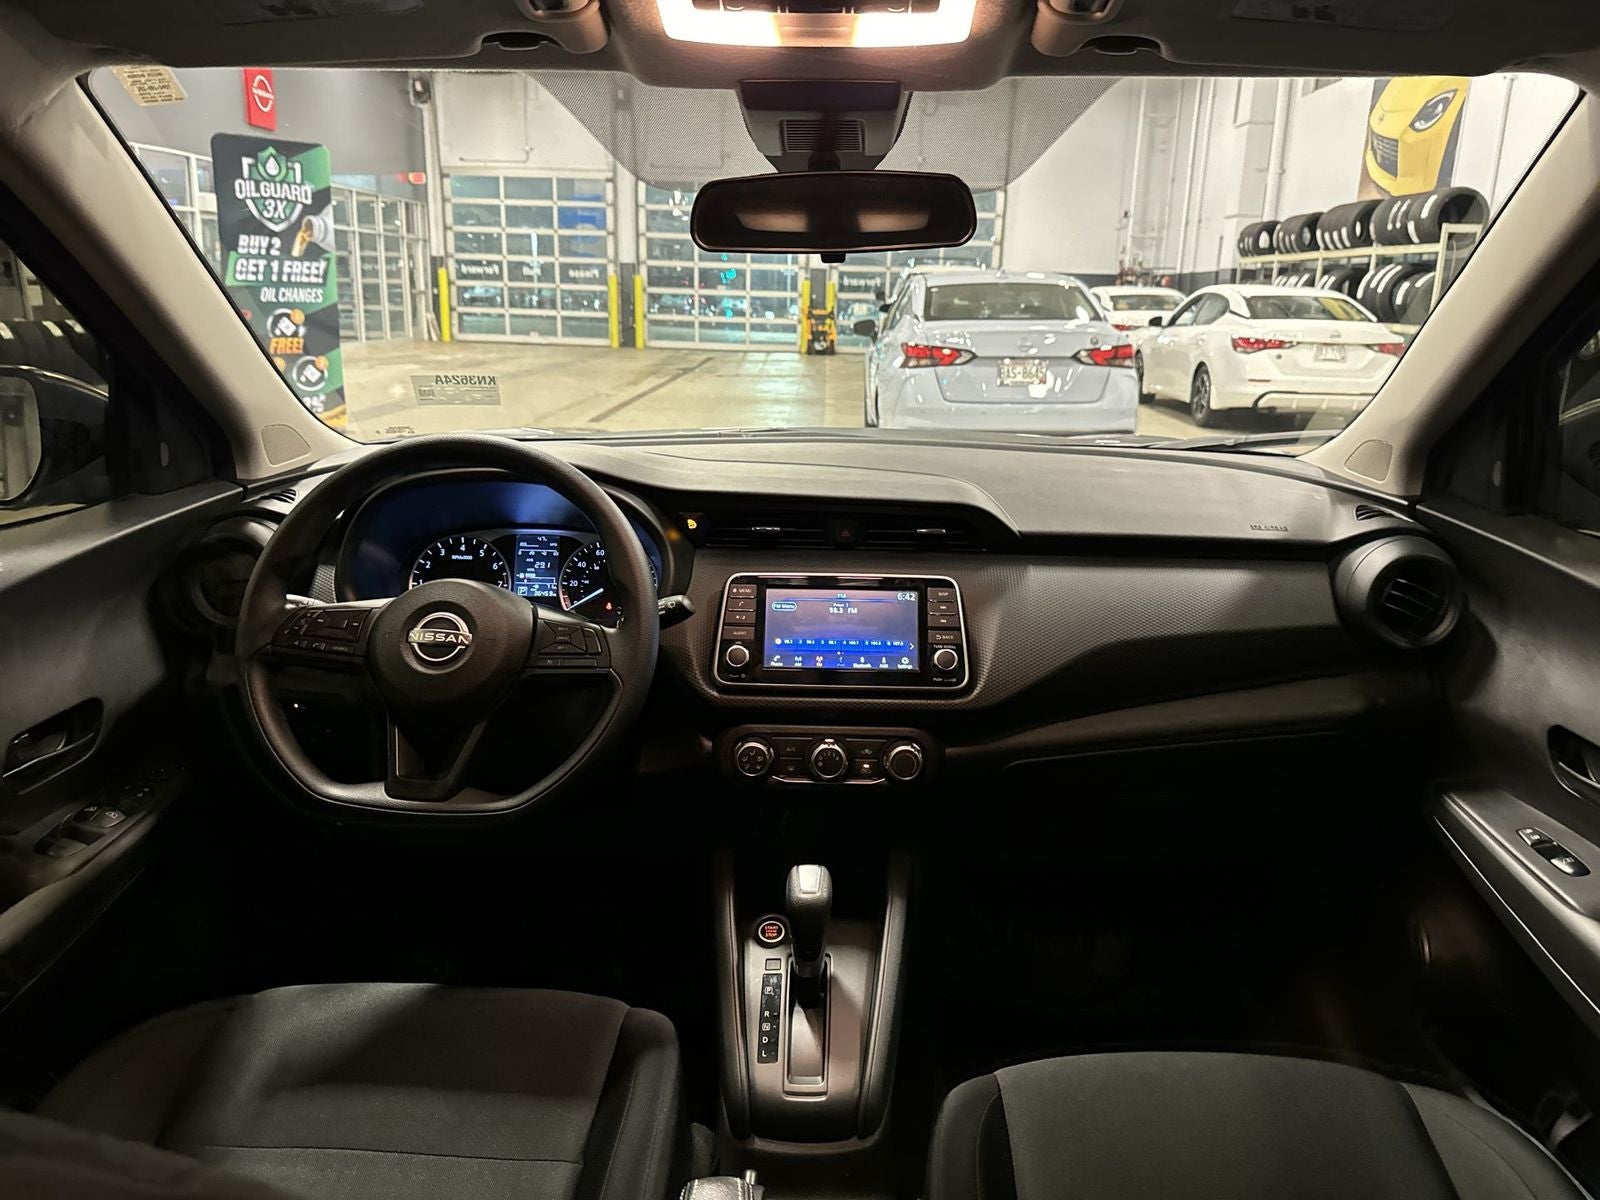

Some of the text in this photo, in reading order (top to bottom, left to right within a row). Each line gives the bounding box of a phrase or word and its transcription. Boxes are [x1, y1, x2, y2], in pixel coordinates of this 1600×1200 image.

[262, 199, 287, 219] 3X
[237, 234, 281, 256] BUY 2
[235, 258, 328, 284] GET 1 FREE!
[260, 286, 324, 304] OIL CHANGES
[460, 544, 466, 552] 4
[479, 549, 485, 557] 5
[425, 561, 431, 569] 2
[492, 562, 498, 570] 6
[569, 579, 579, 587] 20
[897, 593, 916, 601] 6:42
[409, 631, 472, 645] NISSAN
[764, 1010, 770, 1018] R
[762, 1036, 769, 1044] D
[761, 1049, 767, 1057] L
